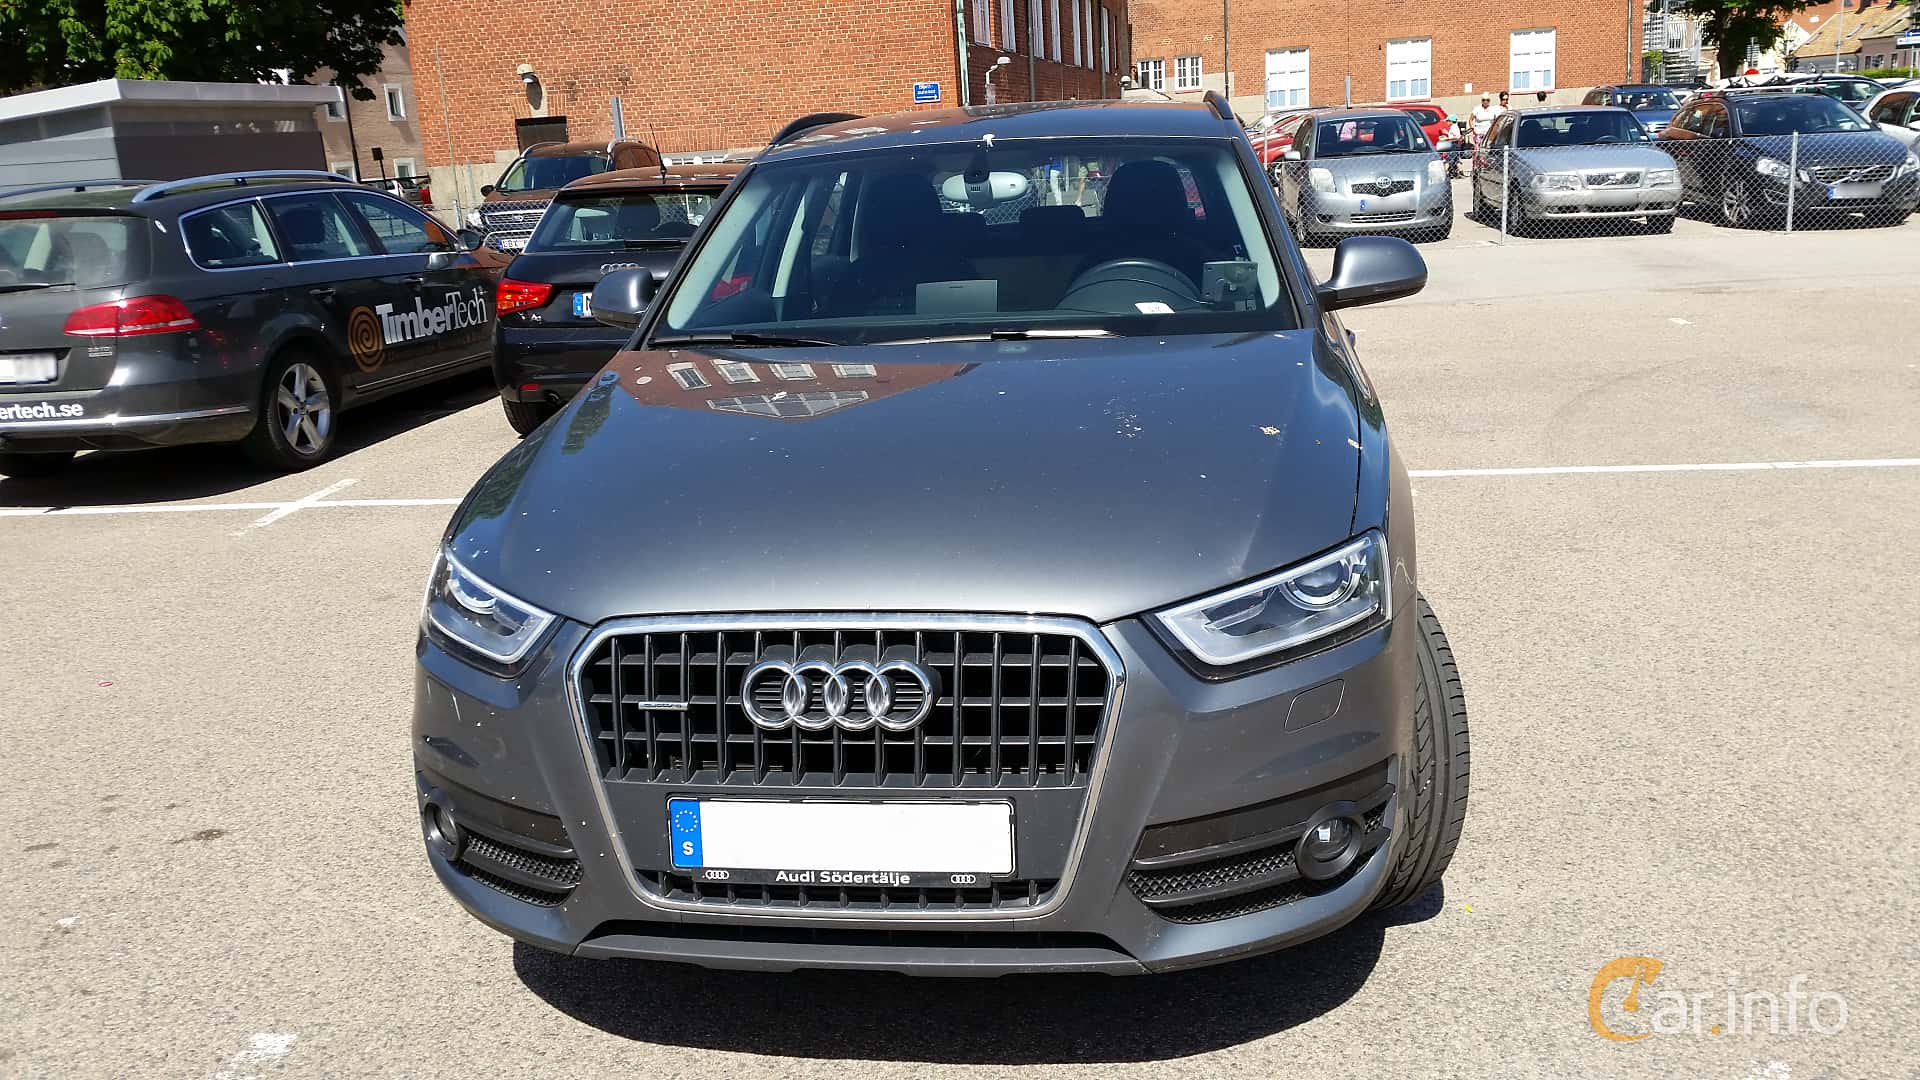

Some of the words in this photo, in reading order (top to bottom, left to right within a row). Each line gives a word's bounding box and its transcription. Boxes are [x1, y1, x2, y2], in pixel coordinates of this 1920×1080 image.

[375, 287, 489, 345] TimberTech
[682, 841, 694, 856] S
[775, 871, 815, 883] Audi
[819, 871, 911, 886] Södertälje
